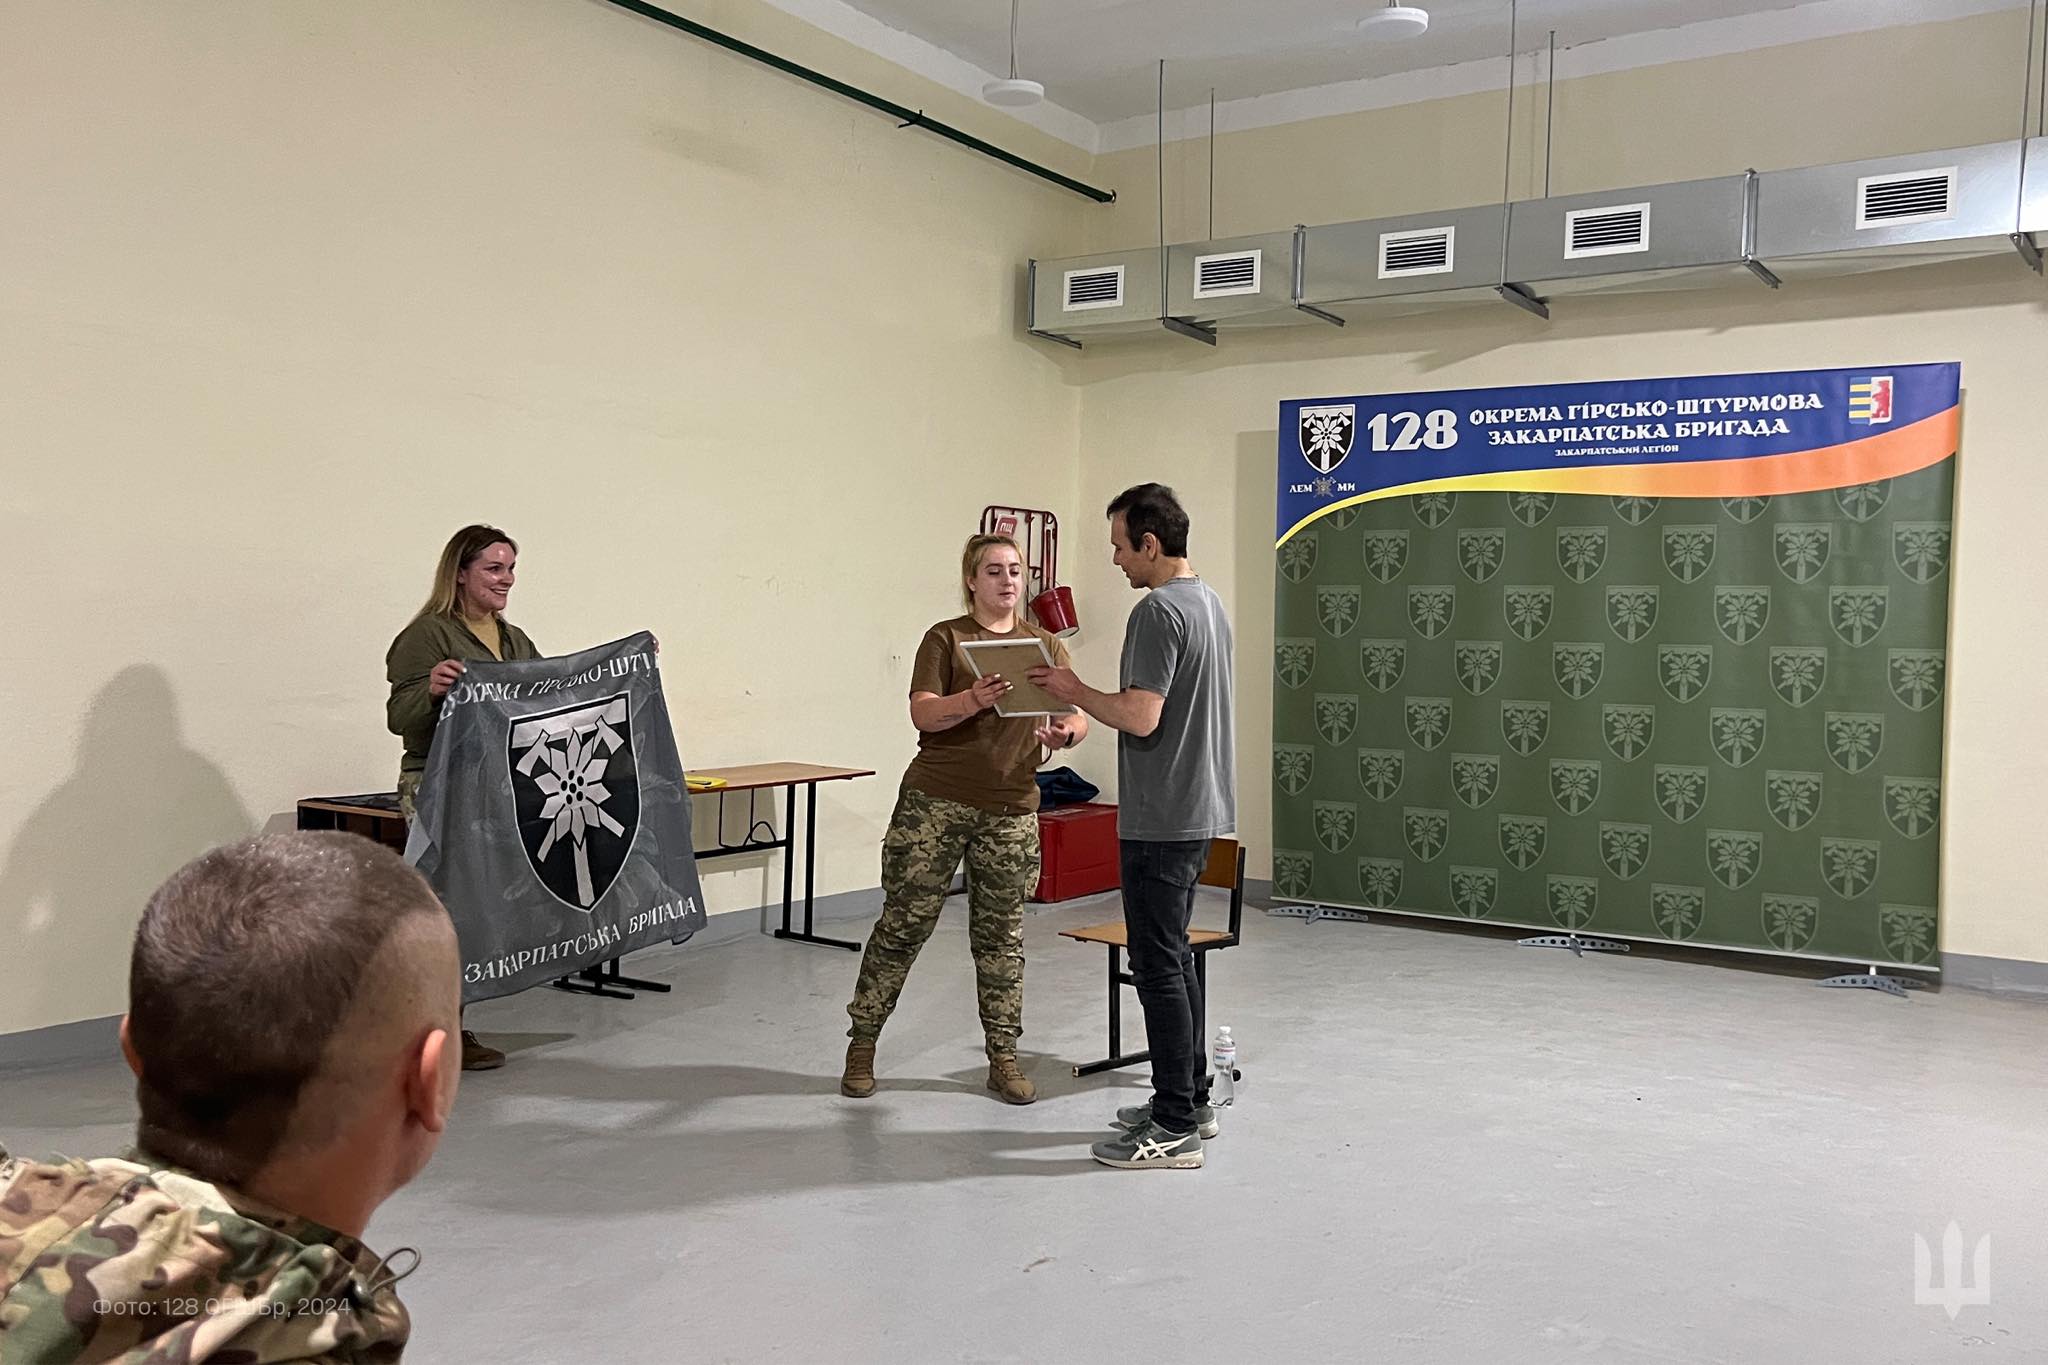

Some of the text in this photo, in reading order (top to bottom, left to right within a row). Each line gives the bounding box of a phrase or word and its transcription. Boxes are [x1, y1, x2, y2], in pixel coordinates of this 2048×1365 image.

[1469, 392, 1824, 425] ОКРЕМА ГІРСЬКО-ШТУРМОВА
[1367, 409, 1458, 451] 128
[1488, 418, 1790, 446] ЗАКАРПАТСЬКА БРИГАДА
[1641, 444, 1679, 453] ЛЕГІОН
[464, 896, 697, 984] ЗАКАРПАТСЬКА БРИГАДА
